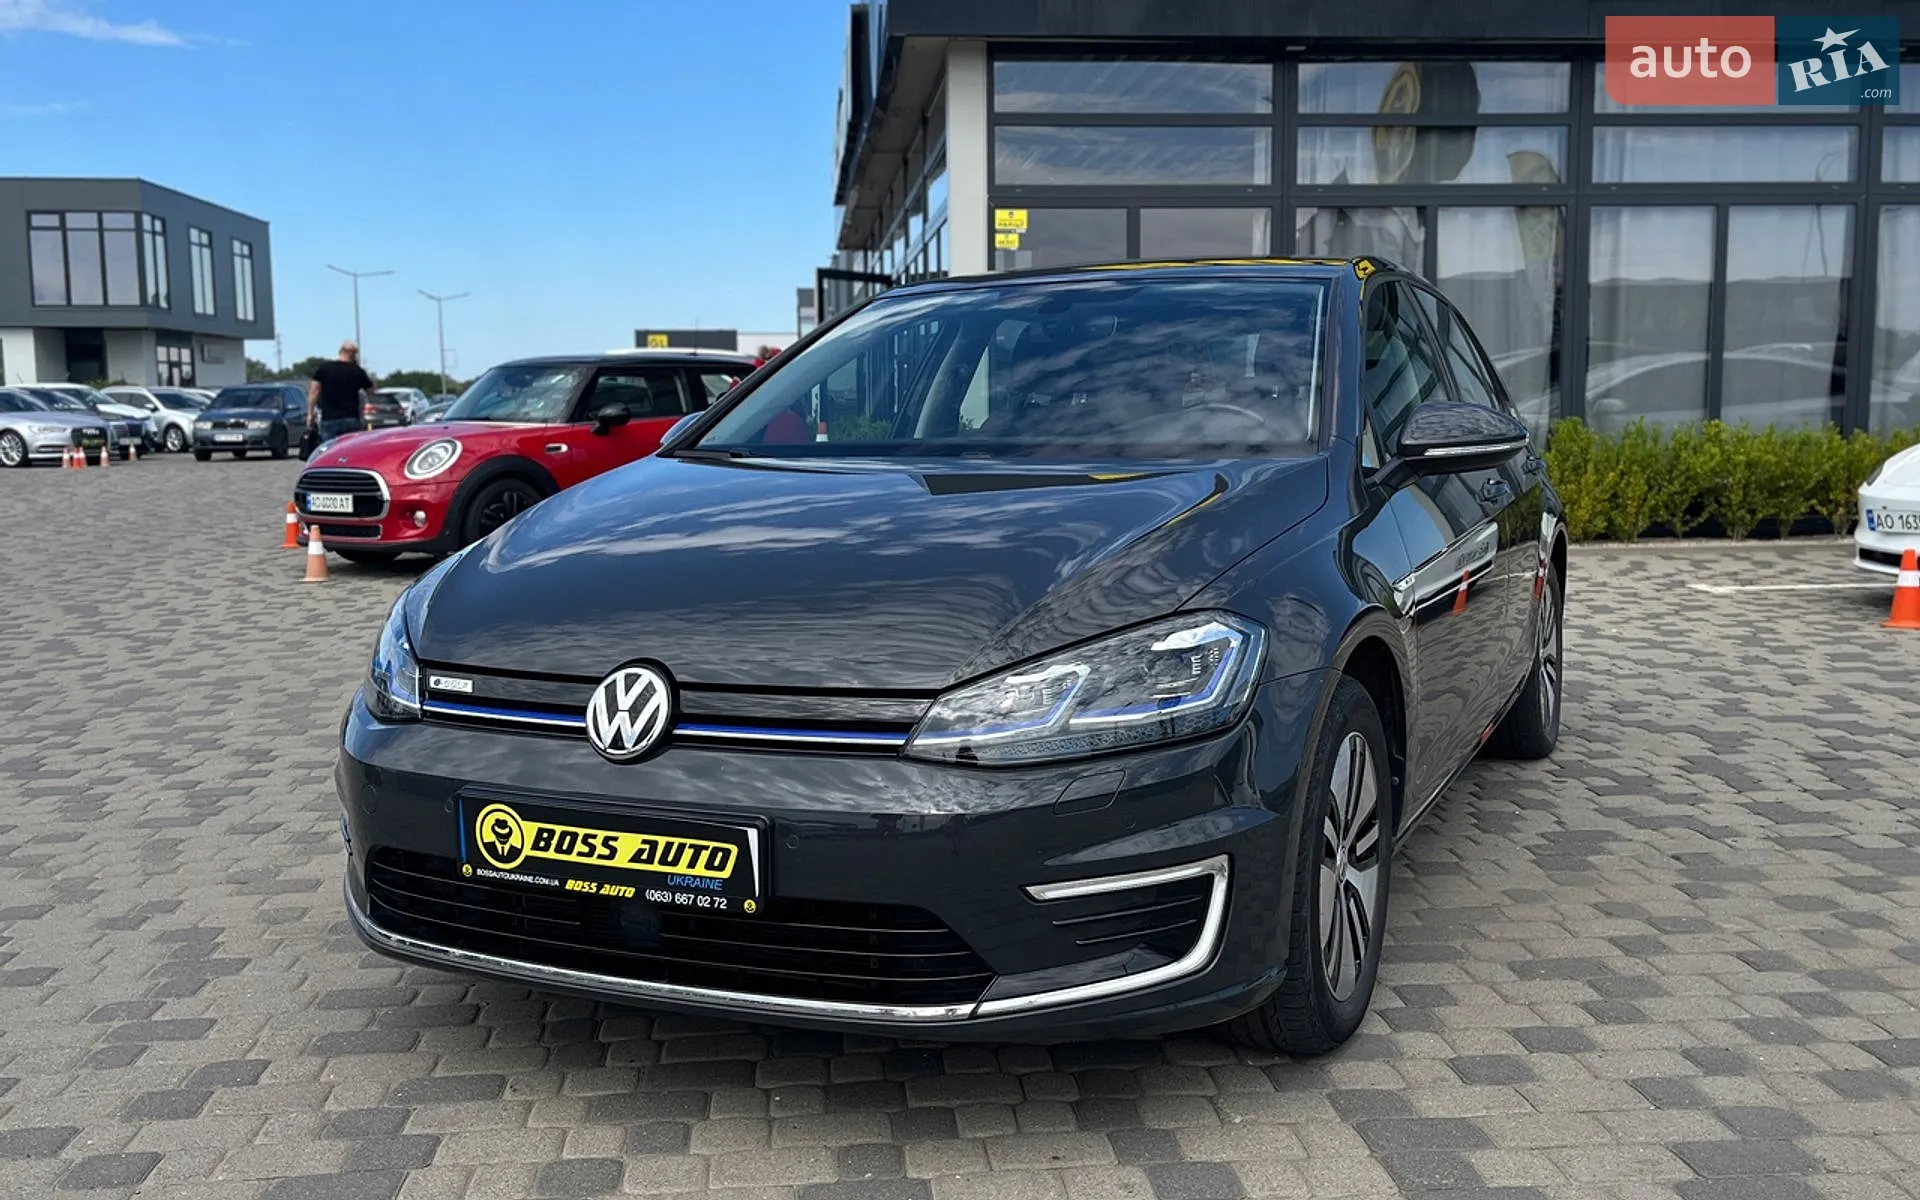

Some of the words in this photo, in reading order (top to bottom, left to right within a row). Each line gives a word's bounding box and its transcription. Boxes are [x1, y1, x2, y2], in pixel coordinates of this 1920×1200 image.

[1876, 513, 1895, 530] AO
[1898, 514, 1920, 531] 163
[530, 826, 619, 861] BOSS
[628, 838, 734, 872] AUTO
[565, 879, 598, 894] BOSS
[599, 884, 636, 898] AUTO
[667, 874, 724, 891] UKRAINE
[645, 889, 672, 903] (063)
[674, 892, 694, 905] 667
[697, 895, 711, 907] 02
[713, 896, 728, 909] 72
